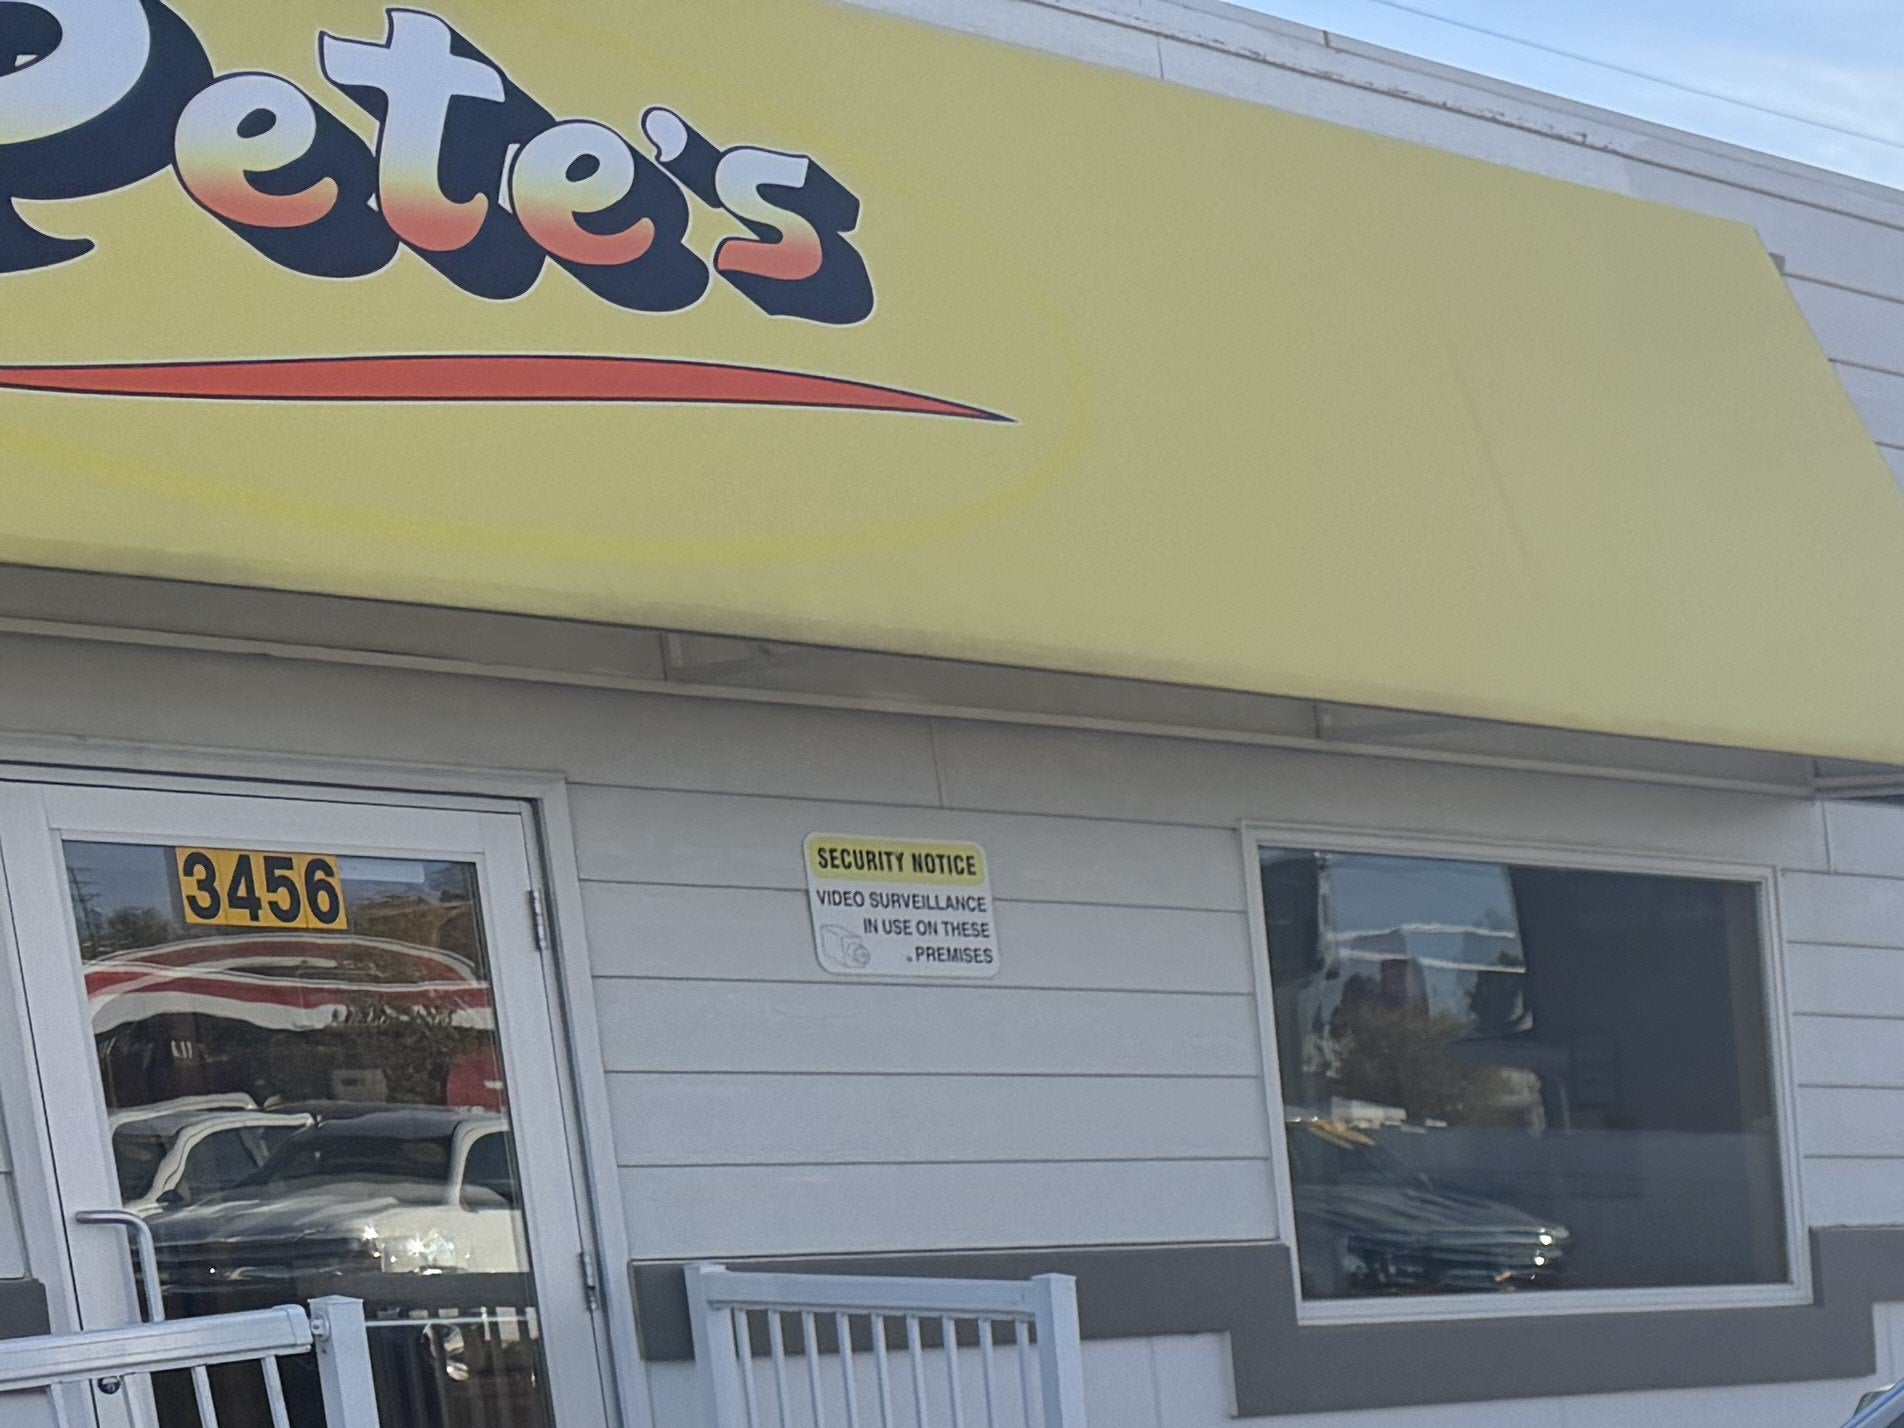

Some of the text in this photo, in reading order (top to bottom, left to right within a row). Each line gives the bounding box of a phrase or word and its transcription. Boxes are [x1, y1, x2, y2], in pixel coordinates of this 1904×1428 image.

[816, 846, 977, 876] SECURITY NOTICE
[183, 851, 341, 925] 3456
[816, 889, 987, 913] VIDEO SURVEILLANCE
[863, 917, 991, 938] IN USE ON THESE
[914, 945, 994, 964] PREMISES
